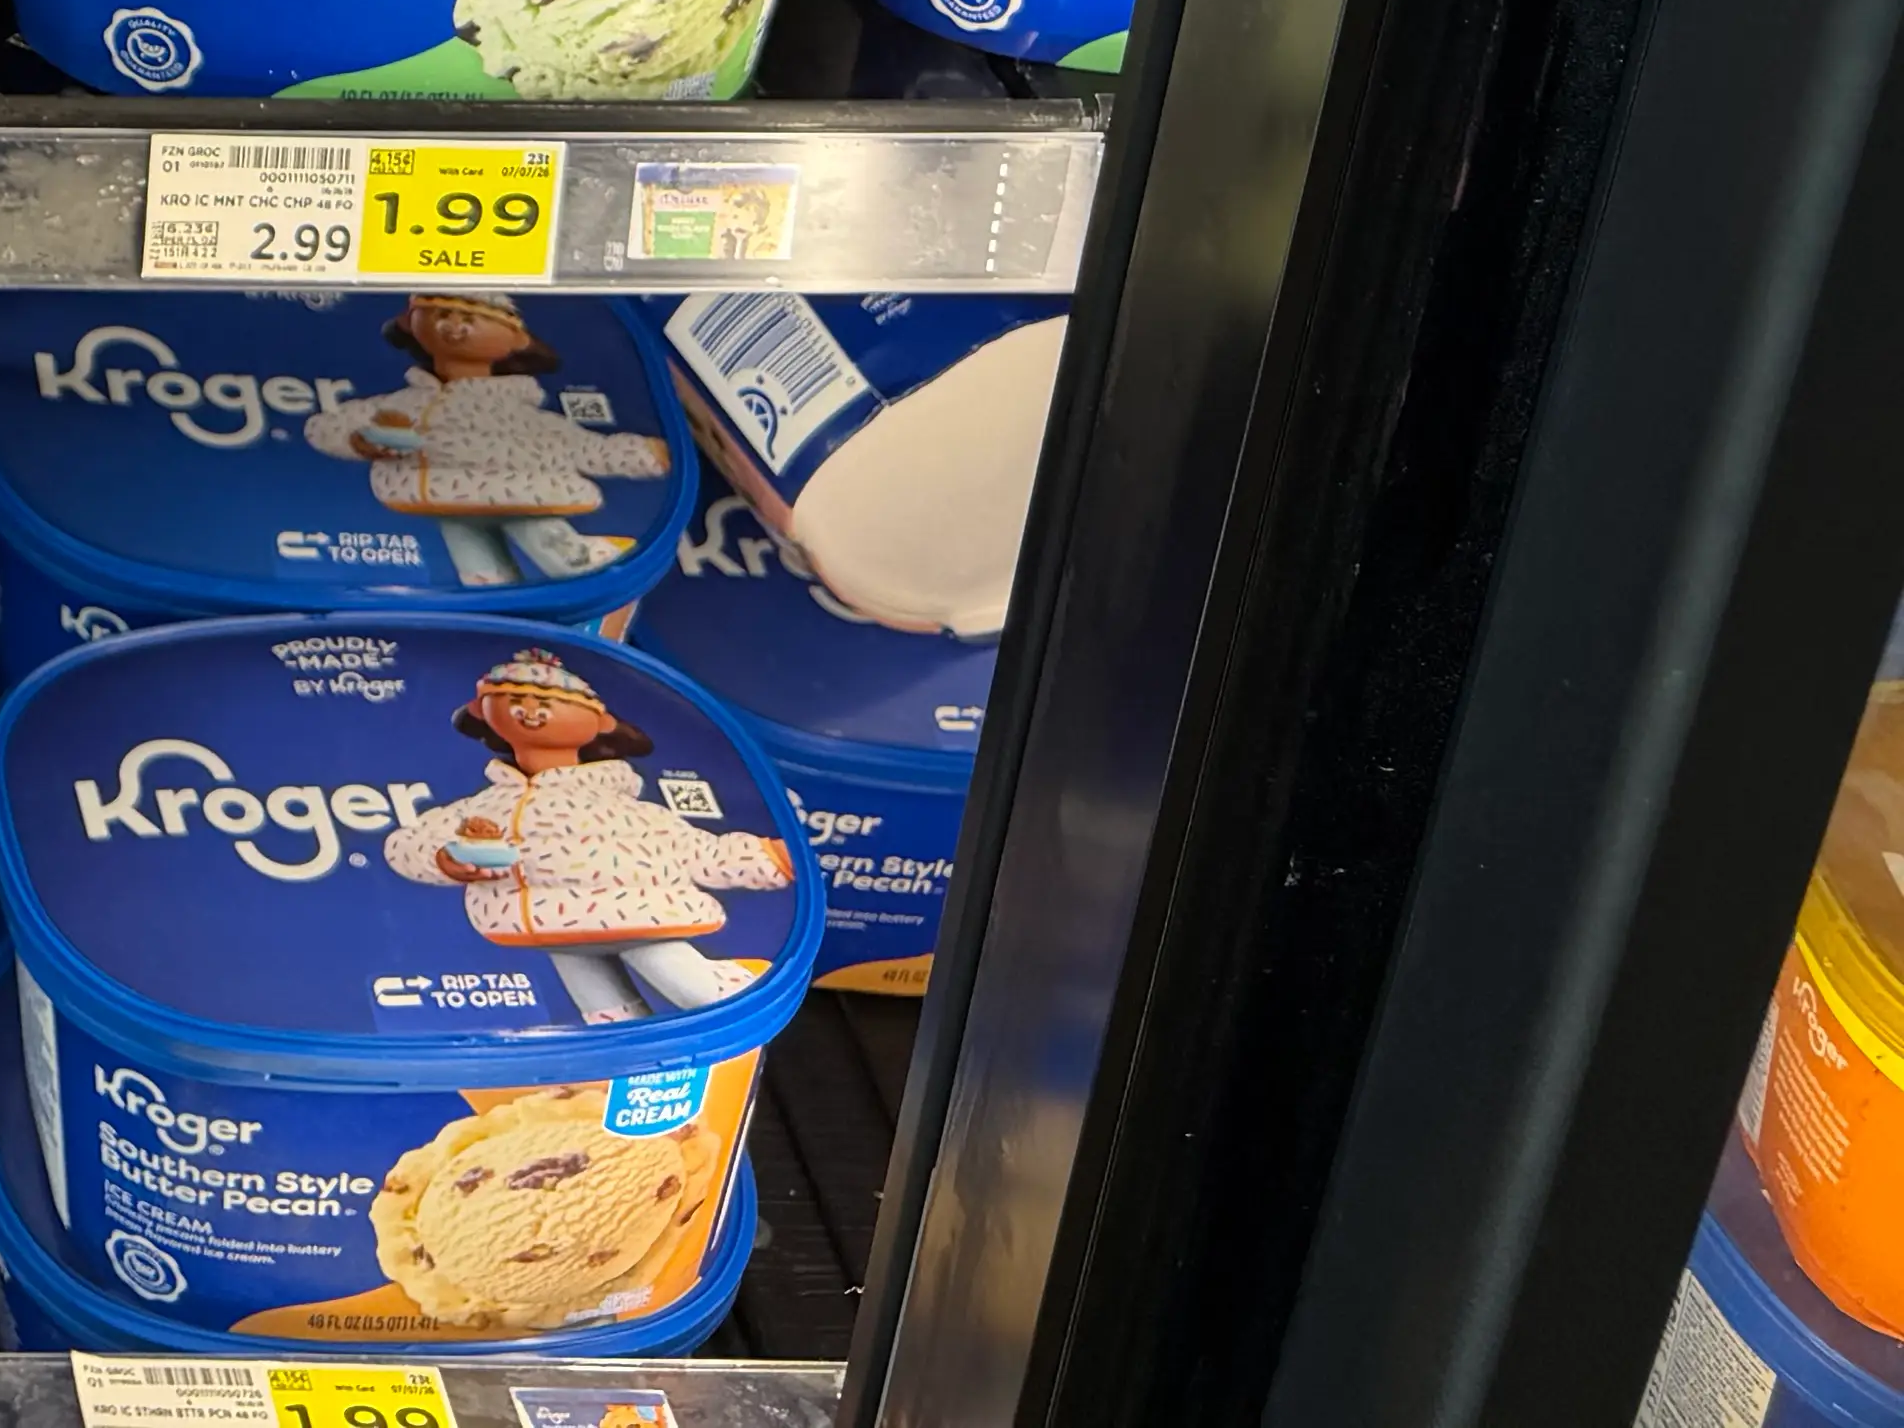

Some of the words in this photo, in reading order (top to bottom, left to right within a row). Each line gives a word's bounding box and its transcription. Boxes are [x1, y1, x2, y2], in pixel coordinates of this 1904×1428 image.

[161, 195, 190, 207] KRO
[195, 195, 208, 207] IC
[212, 196, 244, 208] MNT
[249, 196, 278, 208] CHC
[284, 197, 313, 208] CHP
[374, 192, 540, 237] 1.99
[250, 223, 351, 262] 2.99
[419, 250, 485, 267] SALE
[34, 325, 358, 447] Kroger
[75, 738, 436, 882] Kroger
[1793, 977, 1849, 1072] Kroger
[95, 1065, 262, 1155] Kroger
[616, 1099, 694, 1130] CREAM
[98, 1123, 266, 1195] Southern
[276, 1168, 374, 1196] Style
[100, 1146, 211, 1217] Butter
[224, 1193, 342, 1219] Pecan
